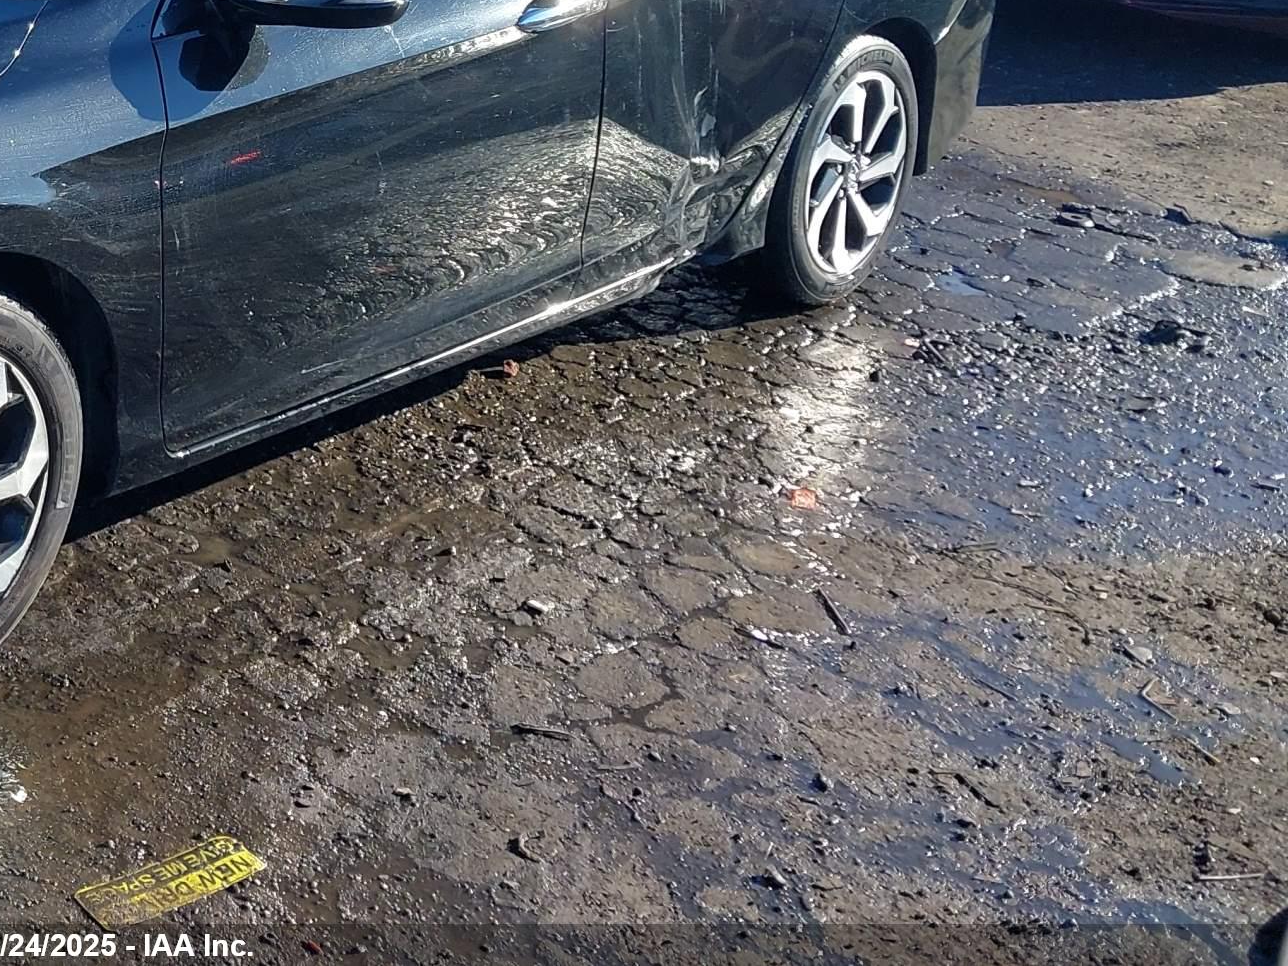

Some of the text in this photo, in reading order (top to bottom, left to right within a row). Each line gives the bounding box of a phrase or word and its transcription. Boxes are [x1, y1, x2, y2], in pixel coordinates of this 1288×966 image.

[83, 840, 237, 907] GIVE ME SPACE
[192, 855, 253, 887] NEW
